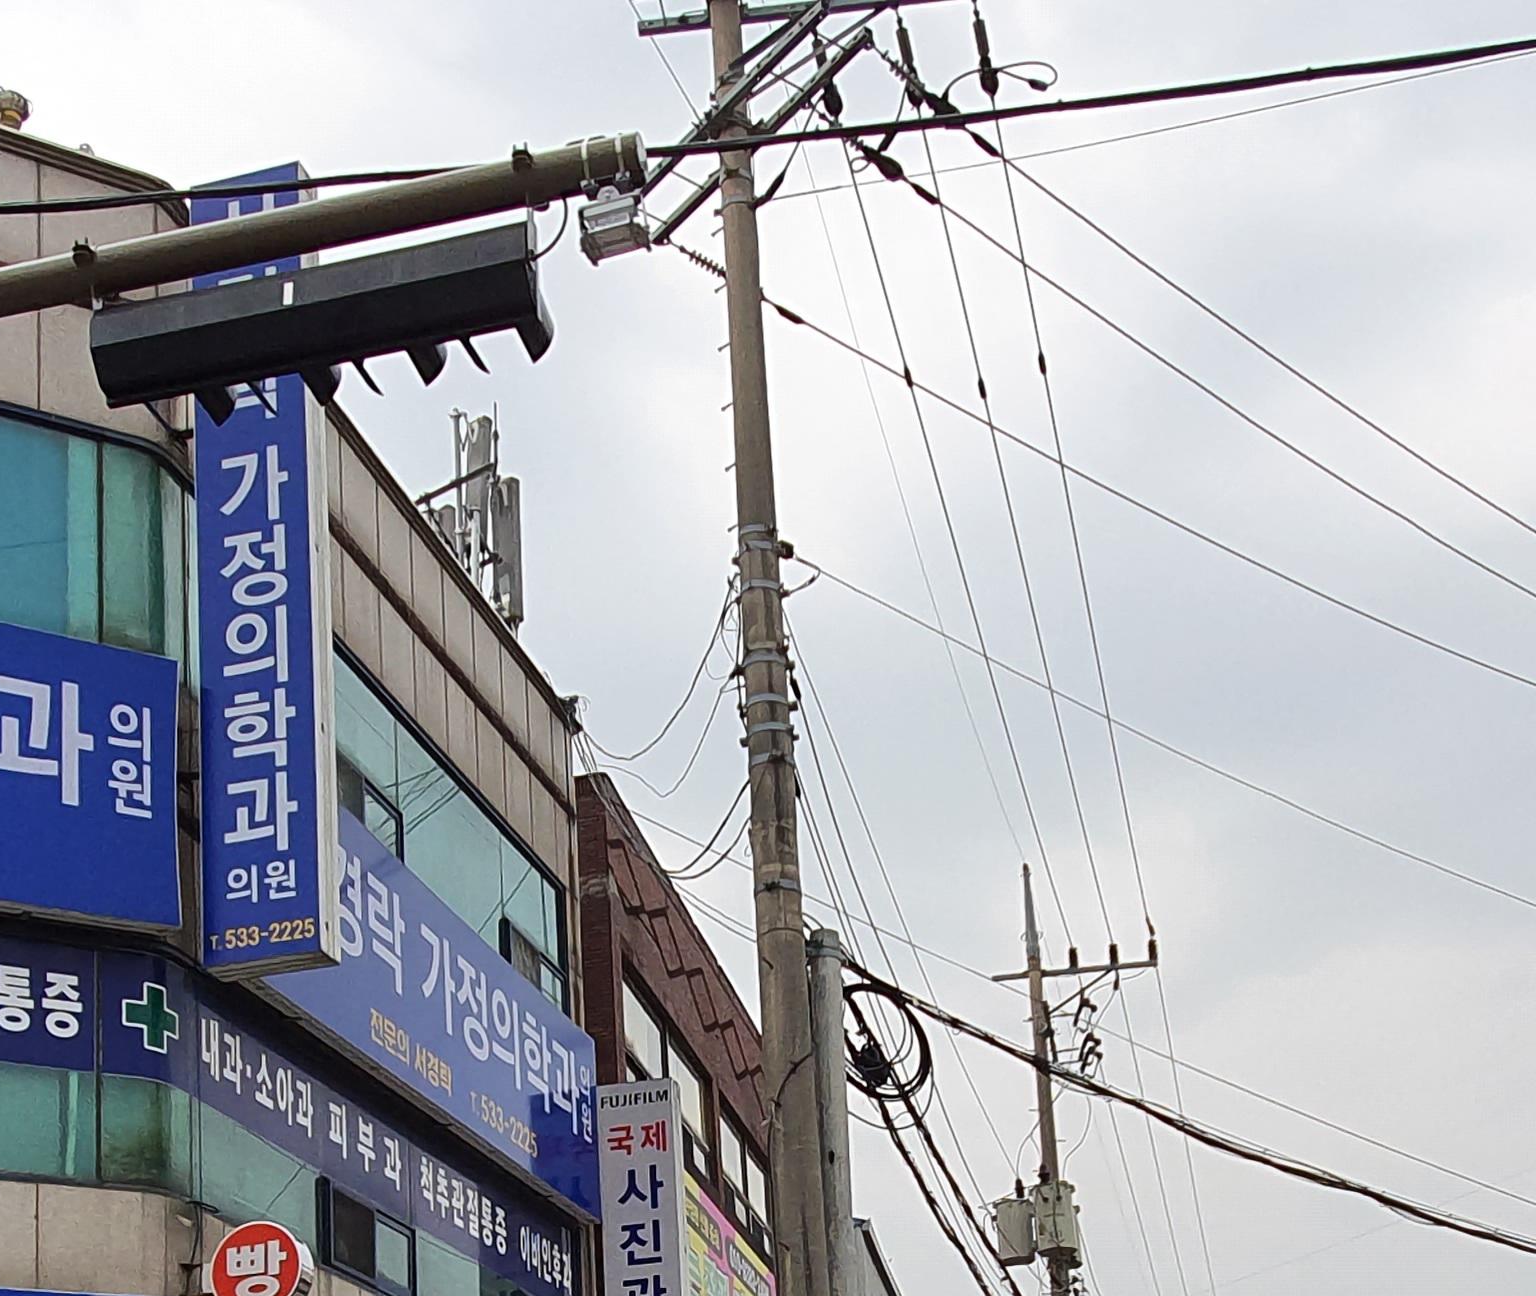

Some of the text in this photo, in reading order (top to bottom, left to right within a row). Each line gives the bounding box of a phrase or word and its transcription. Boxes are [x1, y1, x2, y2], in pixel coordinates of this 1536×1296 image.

[219, 444, 299, 852] 가정의학과
[108, 702, 152, 819] 의원
[226, 857, 297, 904] 의원
[369, 1007, 410, 1067] 전문의
[420, 922, 579, 1136] 가정의학과
[579, 1064, 594, 1144] 의원
[600, 1089, 669, 1110] FUJIFILM
[606, 1119, 668, 1156] 국제
[420, 1154, 507, 1256] 척추관절통증
